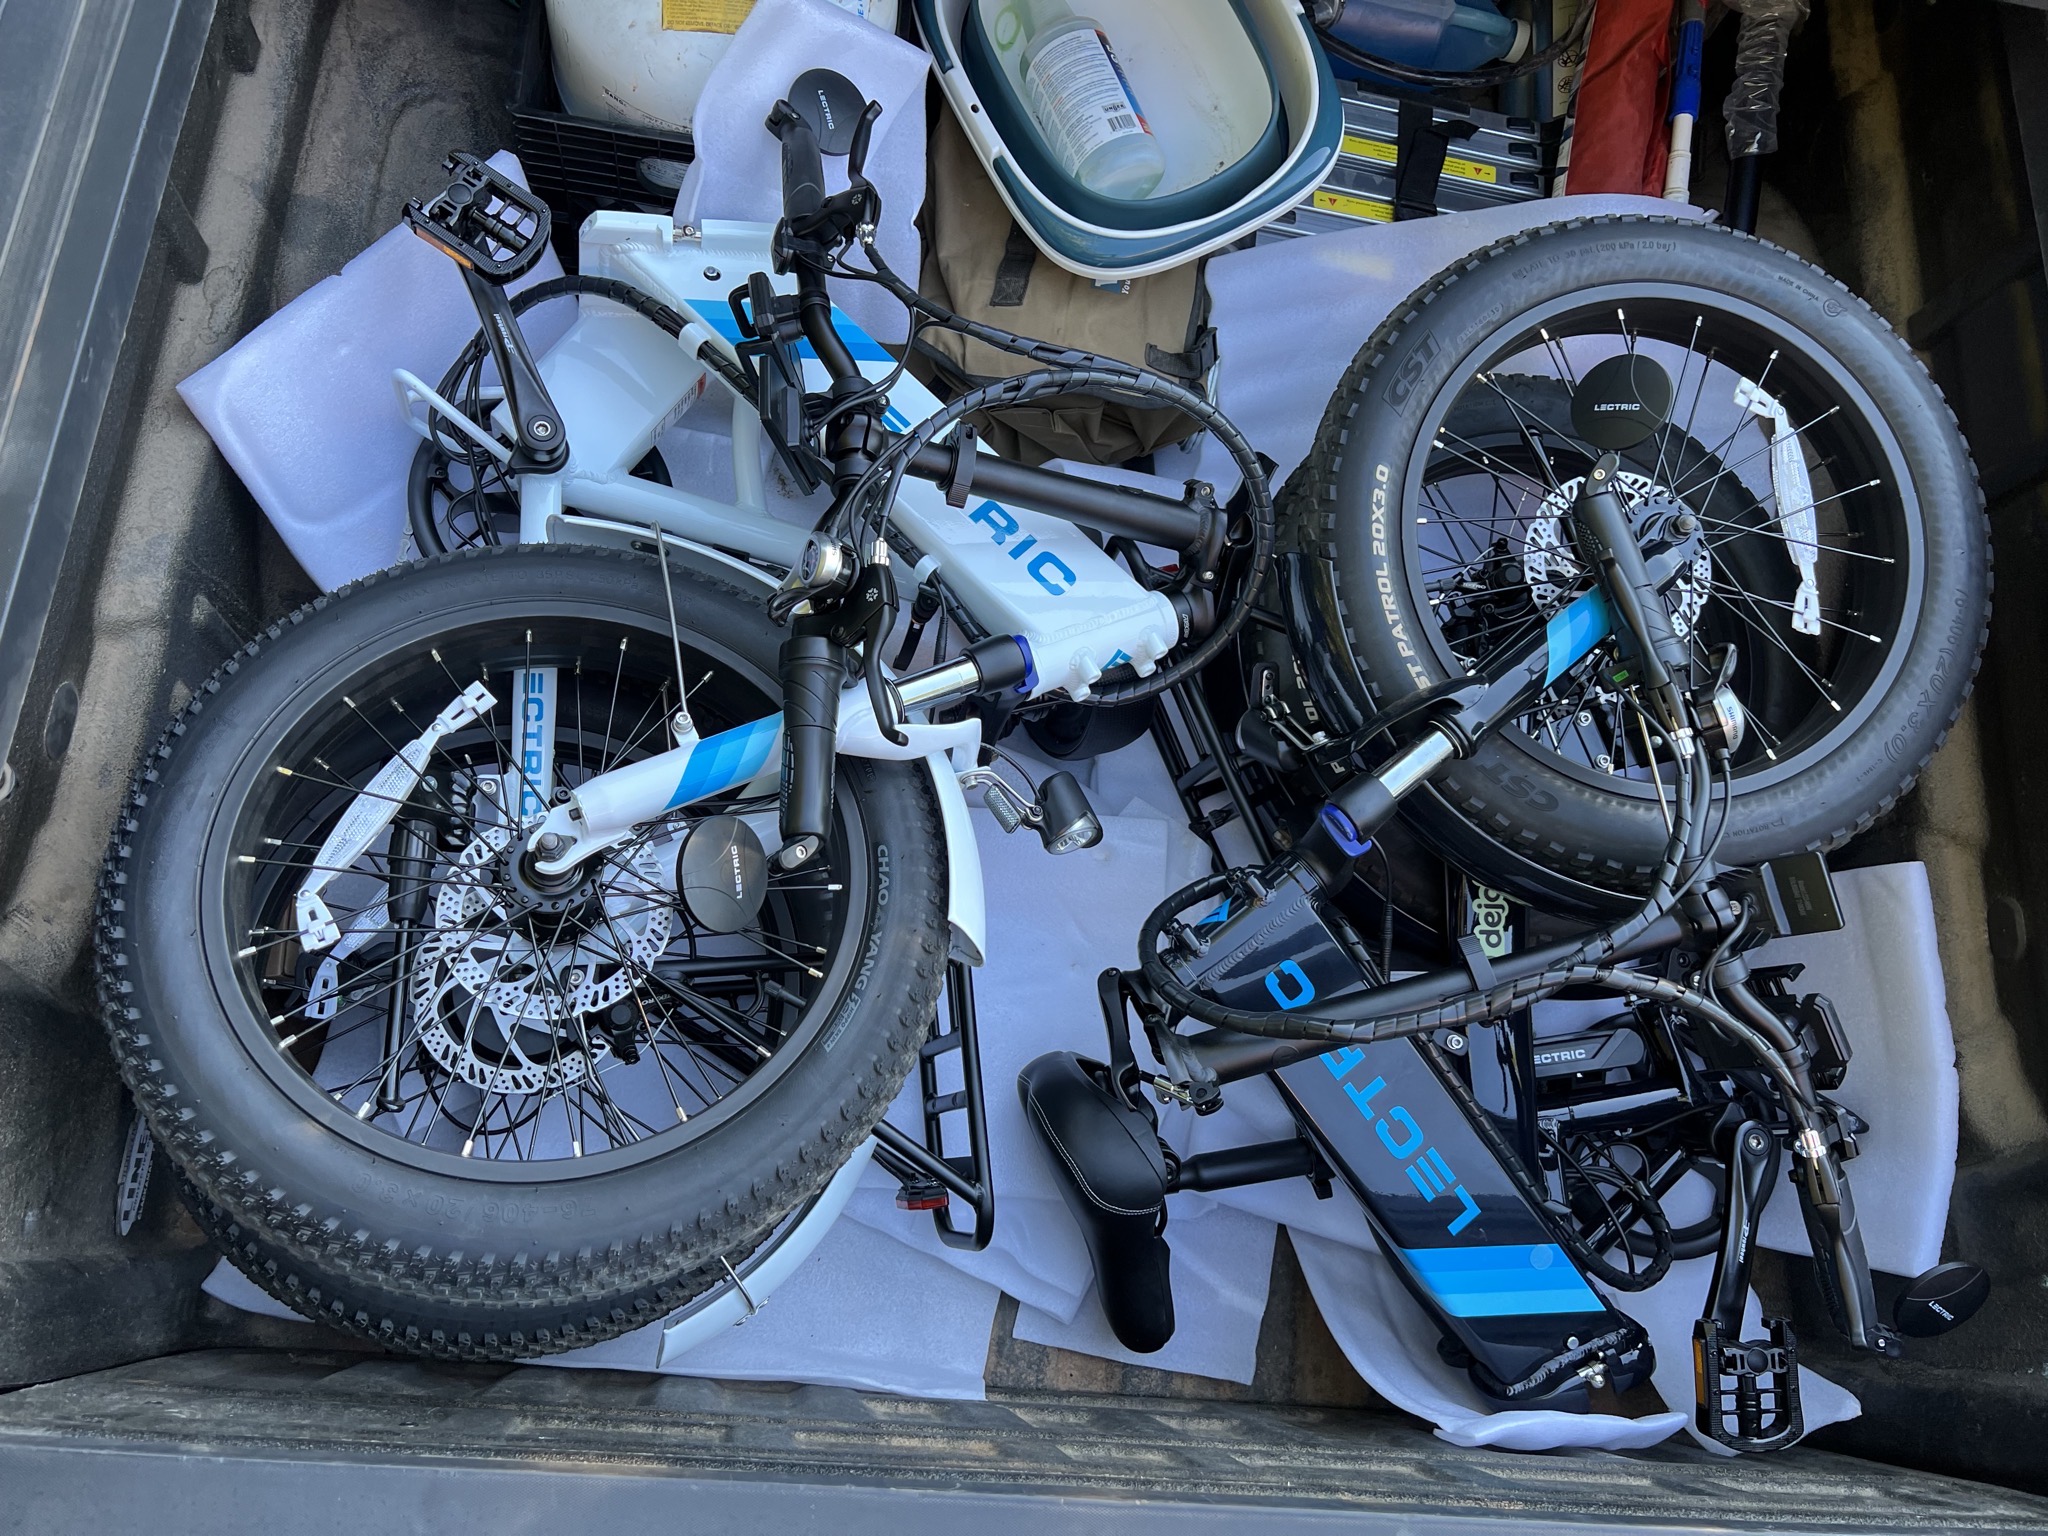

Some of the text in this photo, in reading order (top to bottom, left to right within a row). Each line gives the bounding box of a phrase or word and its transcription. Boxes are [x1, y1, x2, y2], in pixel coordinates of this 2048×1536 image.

[817, 89, 835, 131] LECTRIC
[1642, 241, 1655, 250] 2.0
[1777, 274, 1821, 302] MADE IN CHINA
[1387, 331, 1439, 408] CST
[1593, 403, 1640, 412] LECTRIC
[1371, 463, 1389, 556] 20X3.0
[1377, 562, 1416, 658] PATROL
[1726, 706, 1739, 740] SHIMANO
[1476, 761, 1561, 813] CST
[1732, 823, 1769, 837] ROTATION
[735, 844, 744, 900] LECTRIC
[877, 844, 889, 906] CHAO
[855, 931, 883, 992] YANG
[1533, 1049, 1586, 1065] ECTRIC
[1928, 1300, 1955, 1322] LECTRIC
